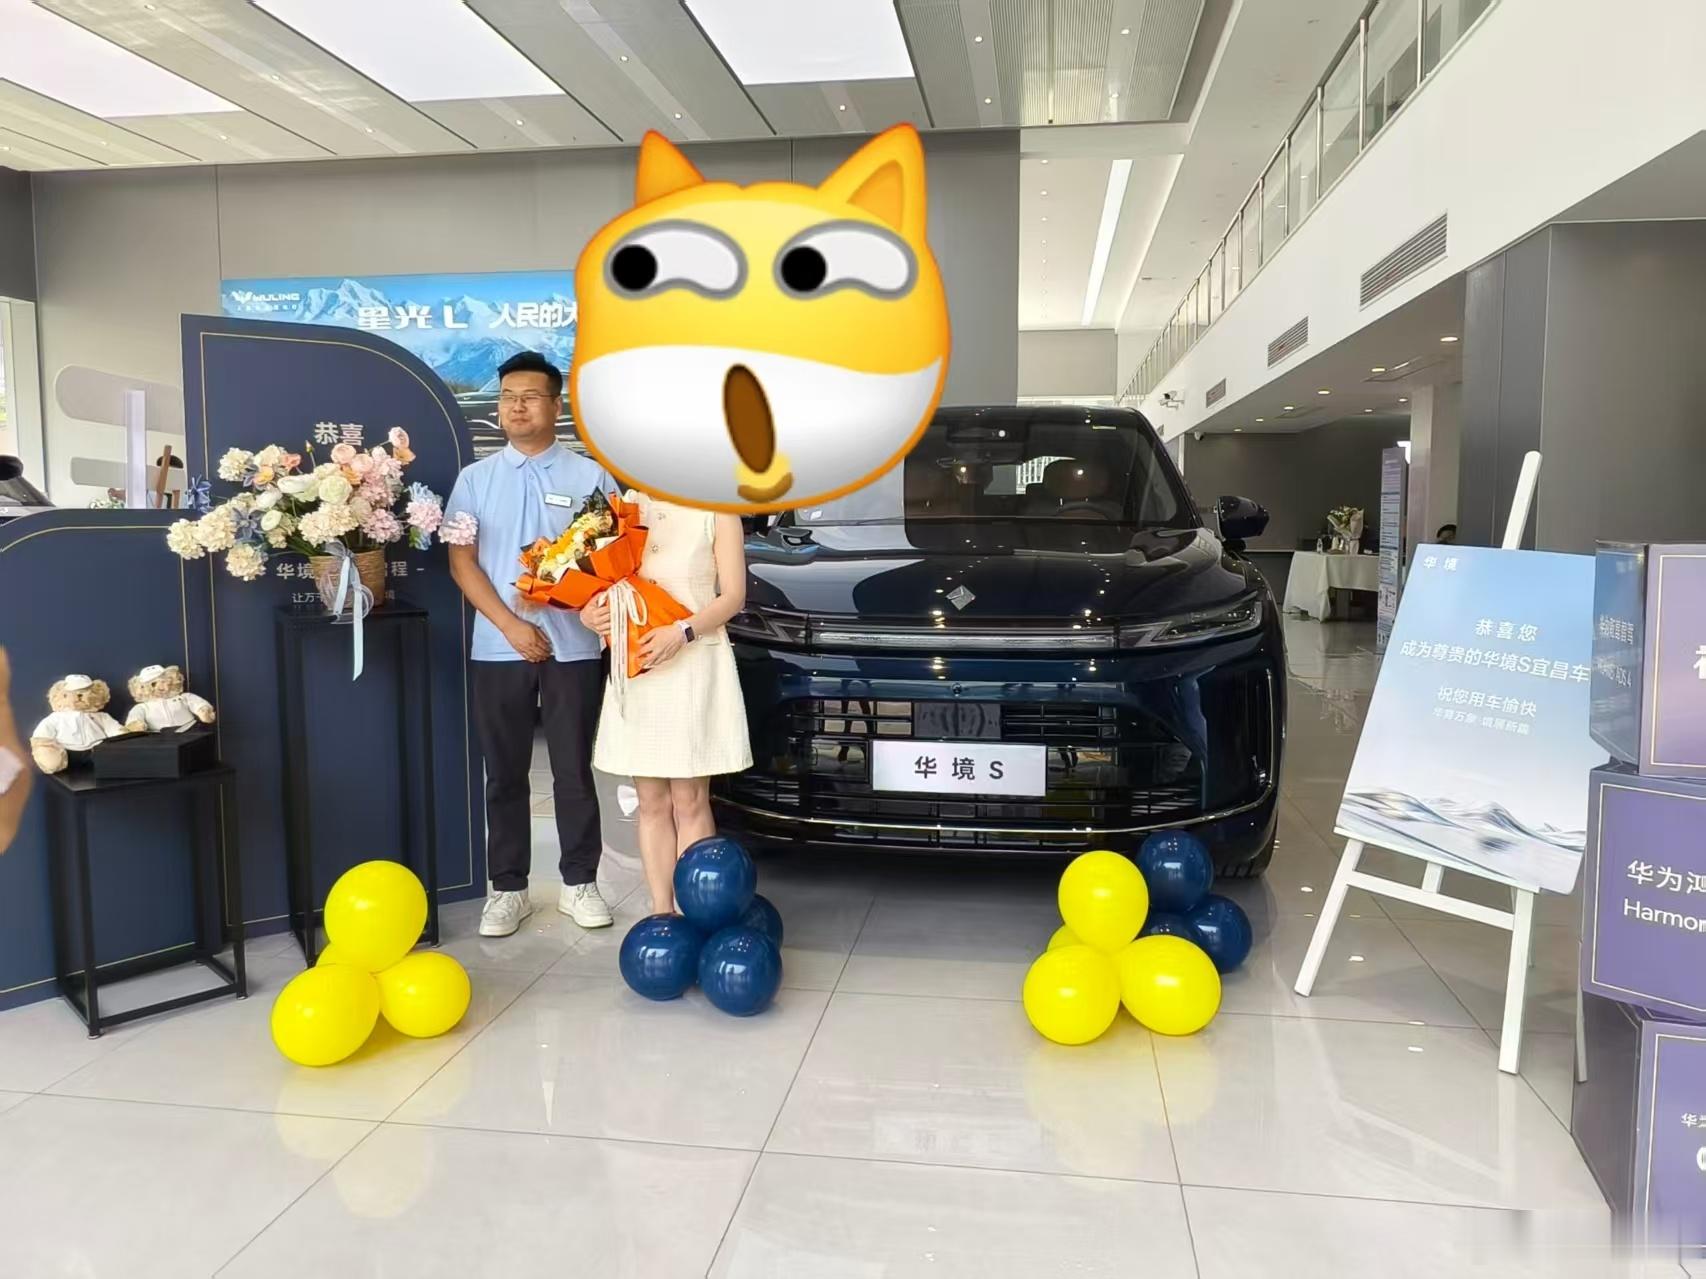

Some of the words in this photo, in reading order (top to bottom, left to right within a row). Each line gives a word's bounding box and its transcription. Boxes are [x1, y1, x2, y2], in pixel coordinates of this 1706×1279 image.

[357, 304, 432, 330] 星光
[443, 305, 469, 329] L
[314, 421, 364, 446] 恭喜
[1475, 618, 1538, 643] 恭喜您
[1400, 639, 1591, 683] 成为尊贵的华境S宜昌车
[1438, 686, 1536, 718] 祝您用车愉快
